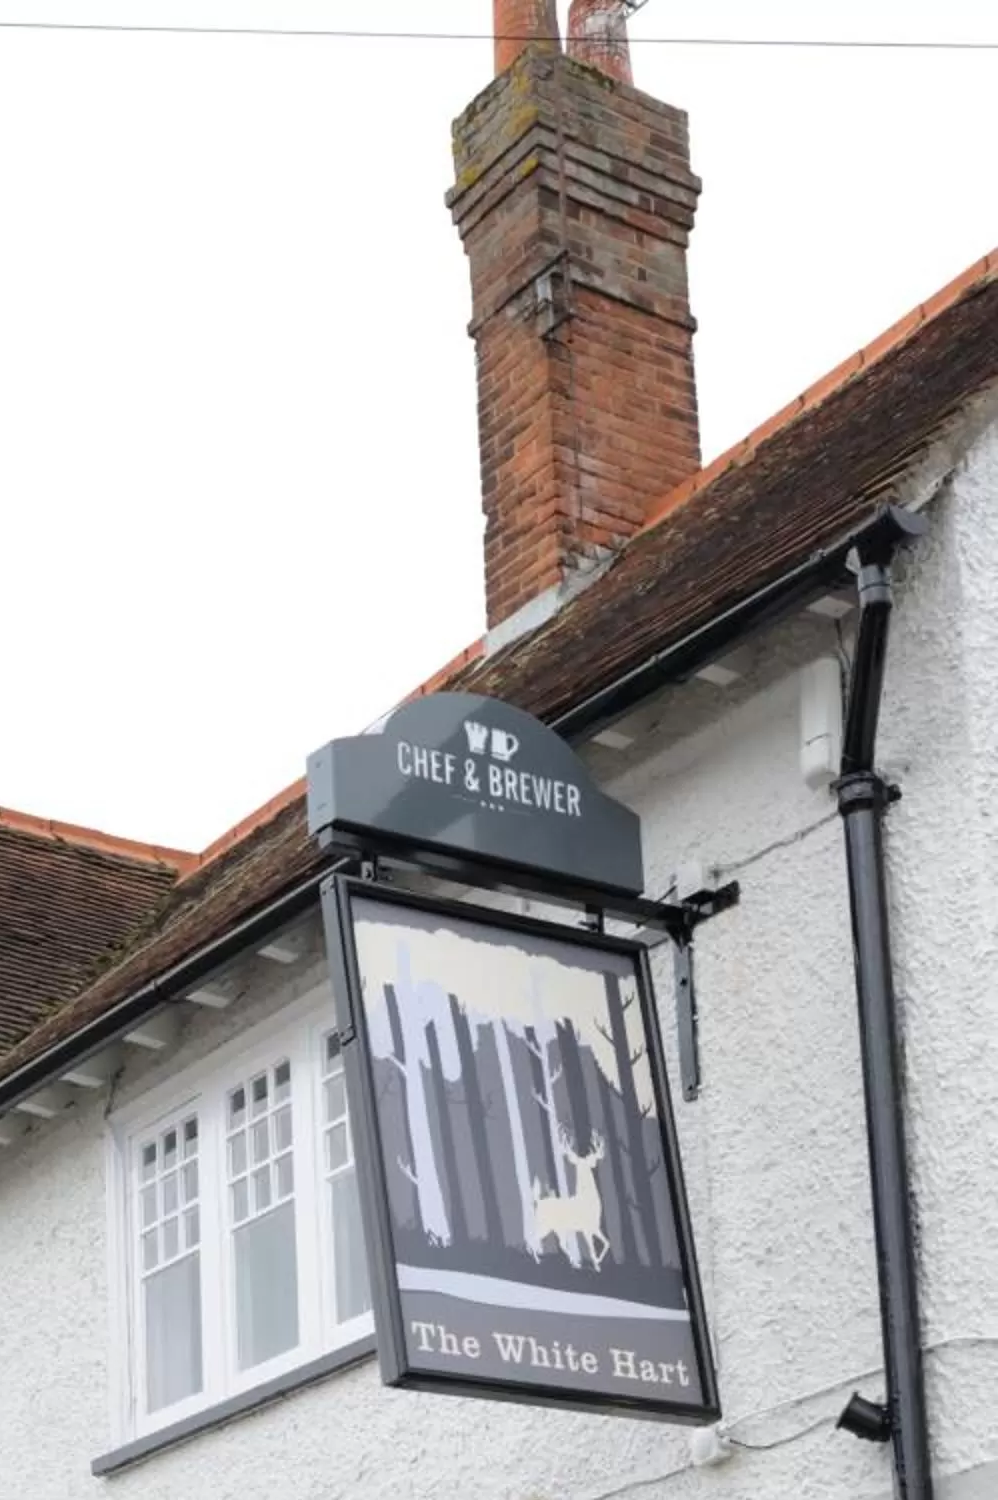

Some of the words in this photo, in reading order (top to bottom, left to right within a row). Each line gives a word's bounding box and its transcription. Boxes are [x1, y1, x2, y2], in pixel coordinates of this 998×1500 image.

[396, 741, 456, 786] CHEF
[463, 757, 480, 793] &
[489, 764, 582, 816] BREWER
[412, 1321, 481, 1359] The
[492, 1331, 600, 1375] White
[609, 1348, 691, 1388] Hart
